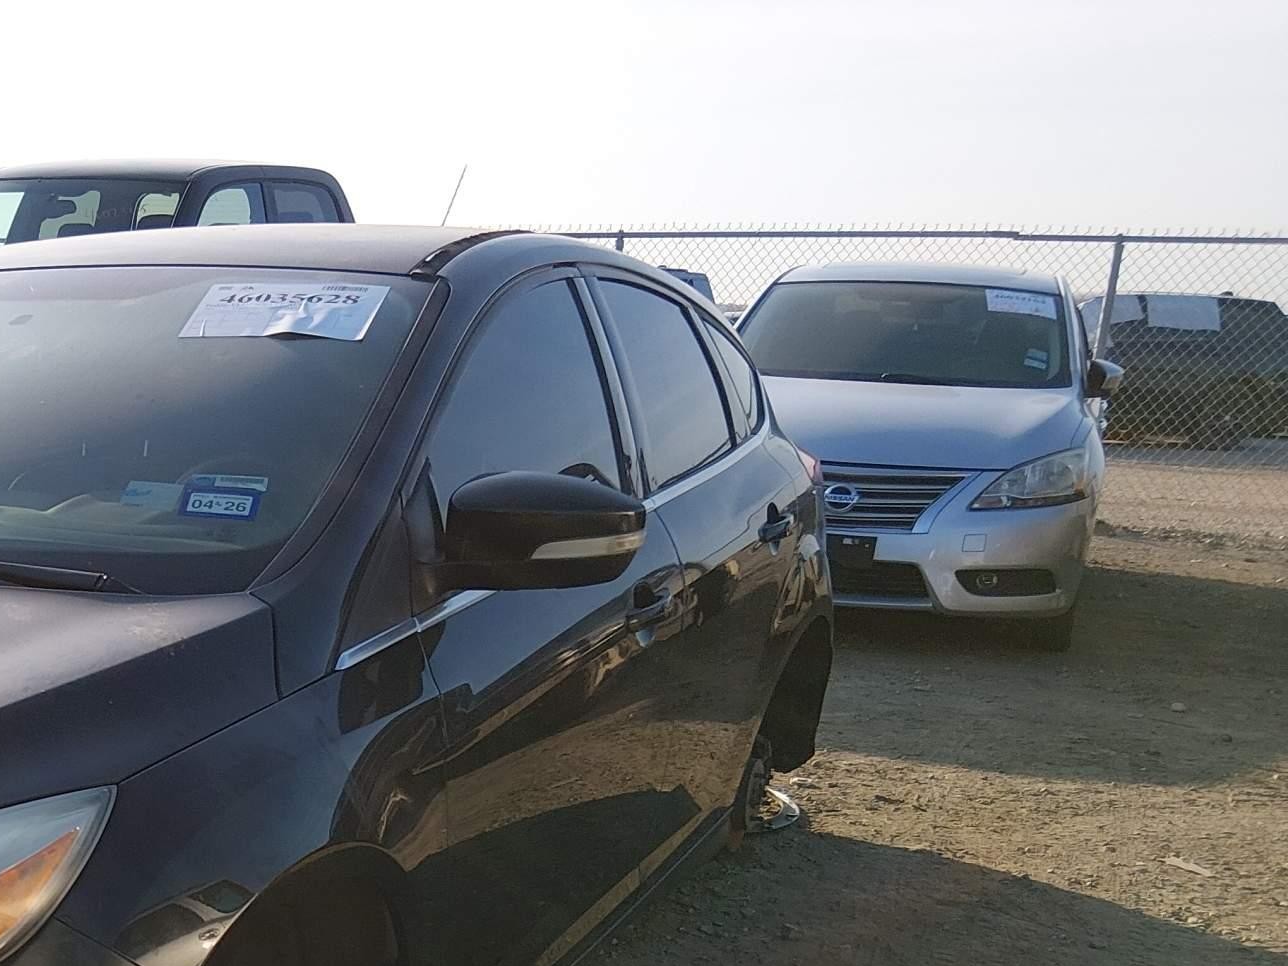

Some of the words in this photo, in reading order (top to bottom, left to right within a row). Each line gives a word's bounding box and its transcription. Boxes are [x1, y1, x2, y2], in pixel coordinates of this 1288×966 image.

[219, 293, 361, 305] 46035628
[191, 499, 214, 510] 04
[223, 501, 247, 512] 26
